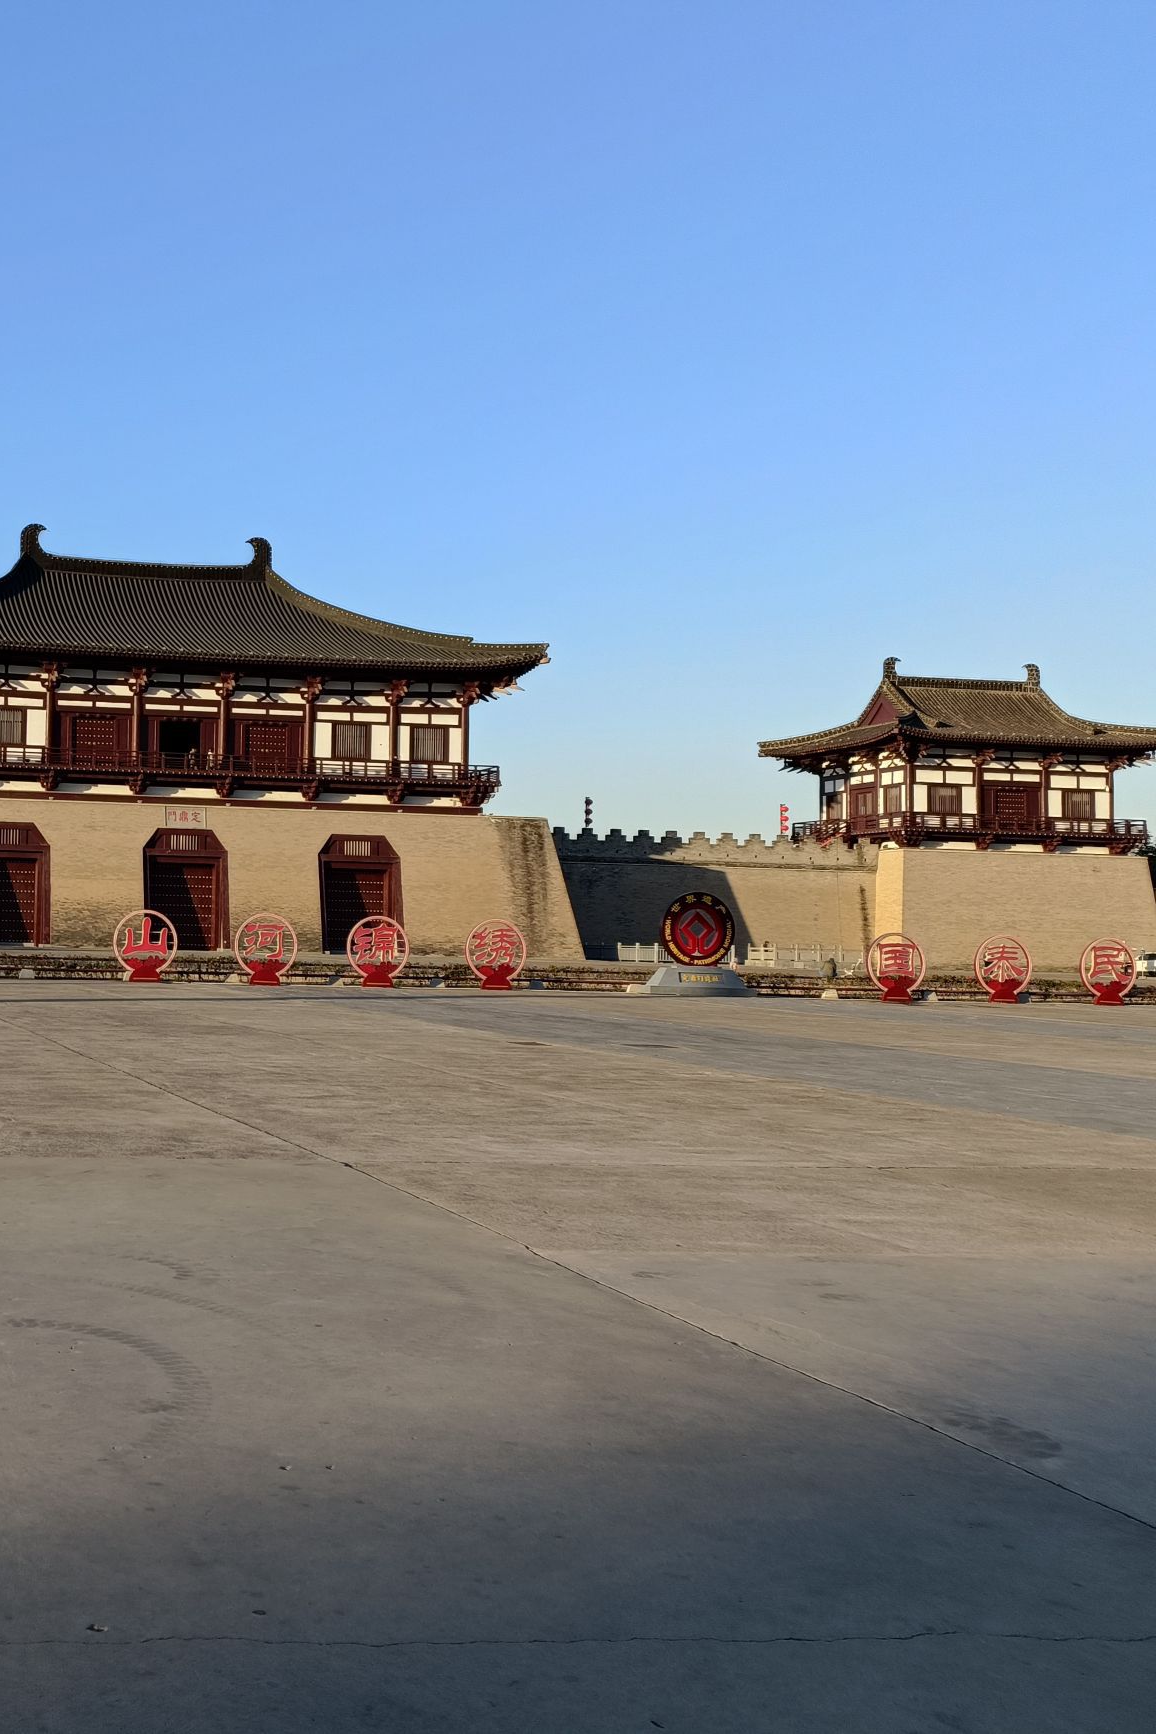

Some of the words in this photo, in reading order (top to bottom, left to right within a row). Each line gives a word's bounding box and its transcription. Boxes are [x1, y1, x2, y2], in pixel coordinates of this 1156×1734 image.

[167, 810, 202, 823] 定鼎門
[671, 895, 726, 914] 世界遗产
[122, 916, 168, 957] 山
[243, 922, 285, 960] 河
[353, 922, 399, 964] 锦
[472, 926, 520, 966] 绣
[668, 941, 691, 964] HERITAGE
[876, 942, 917, 978] 国
[981, 943, 1026, 983] 泰
[1088, 945, 1132, 982] 民
